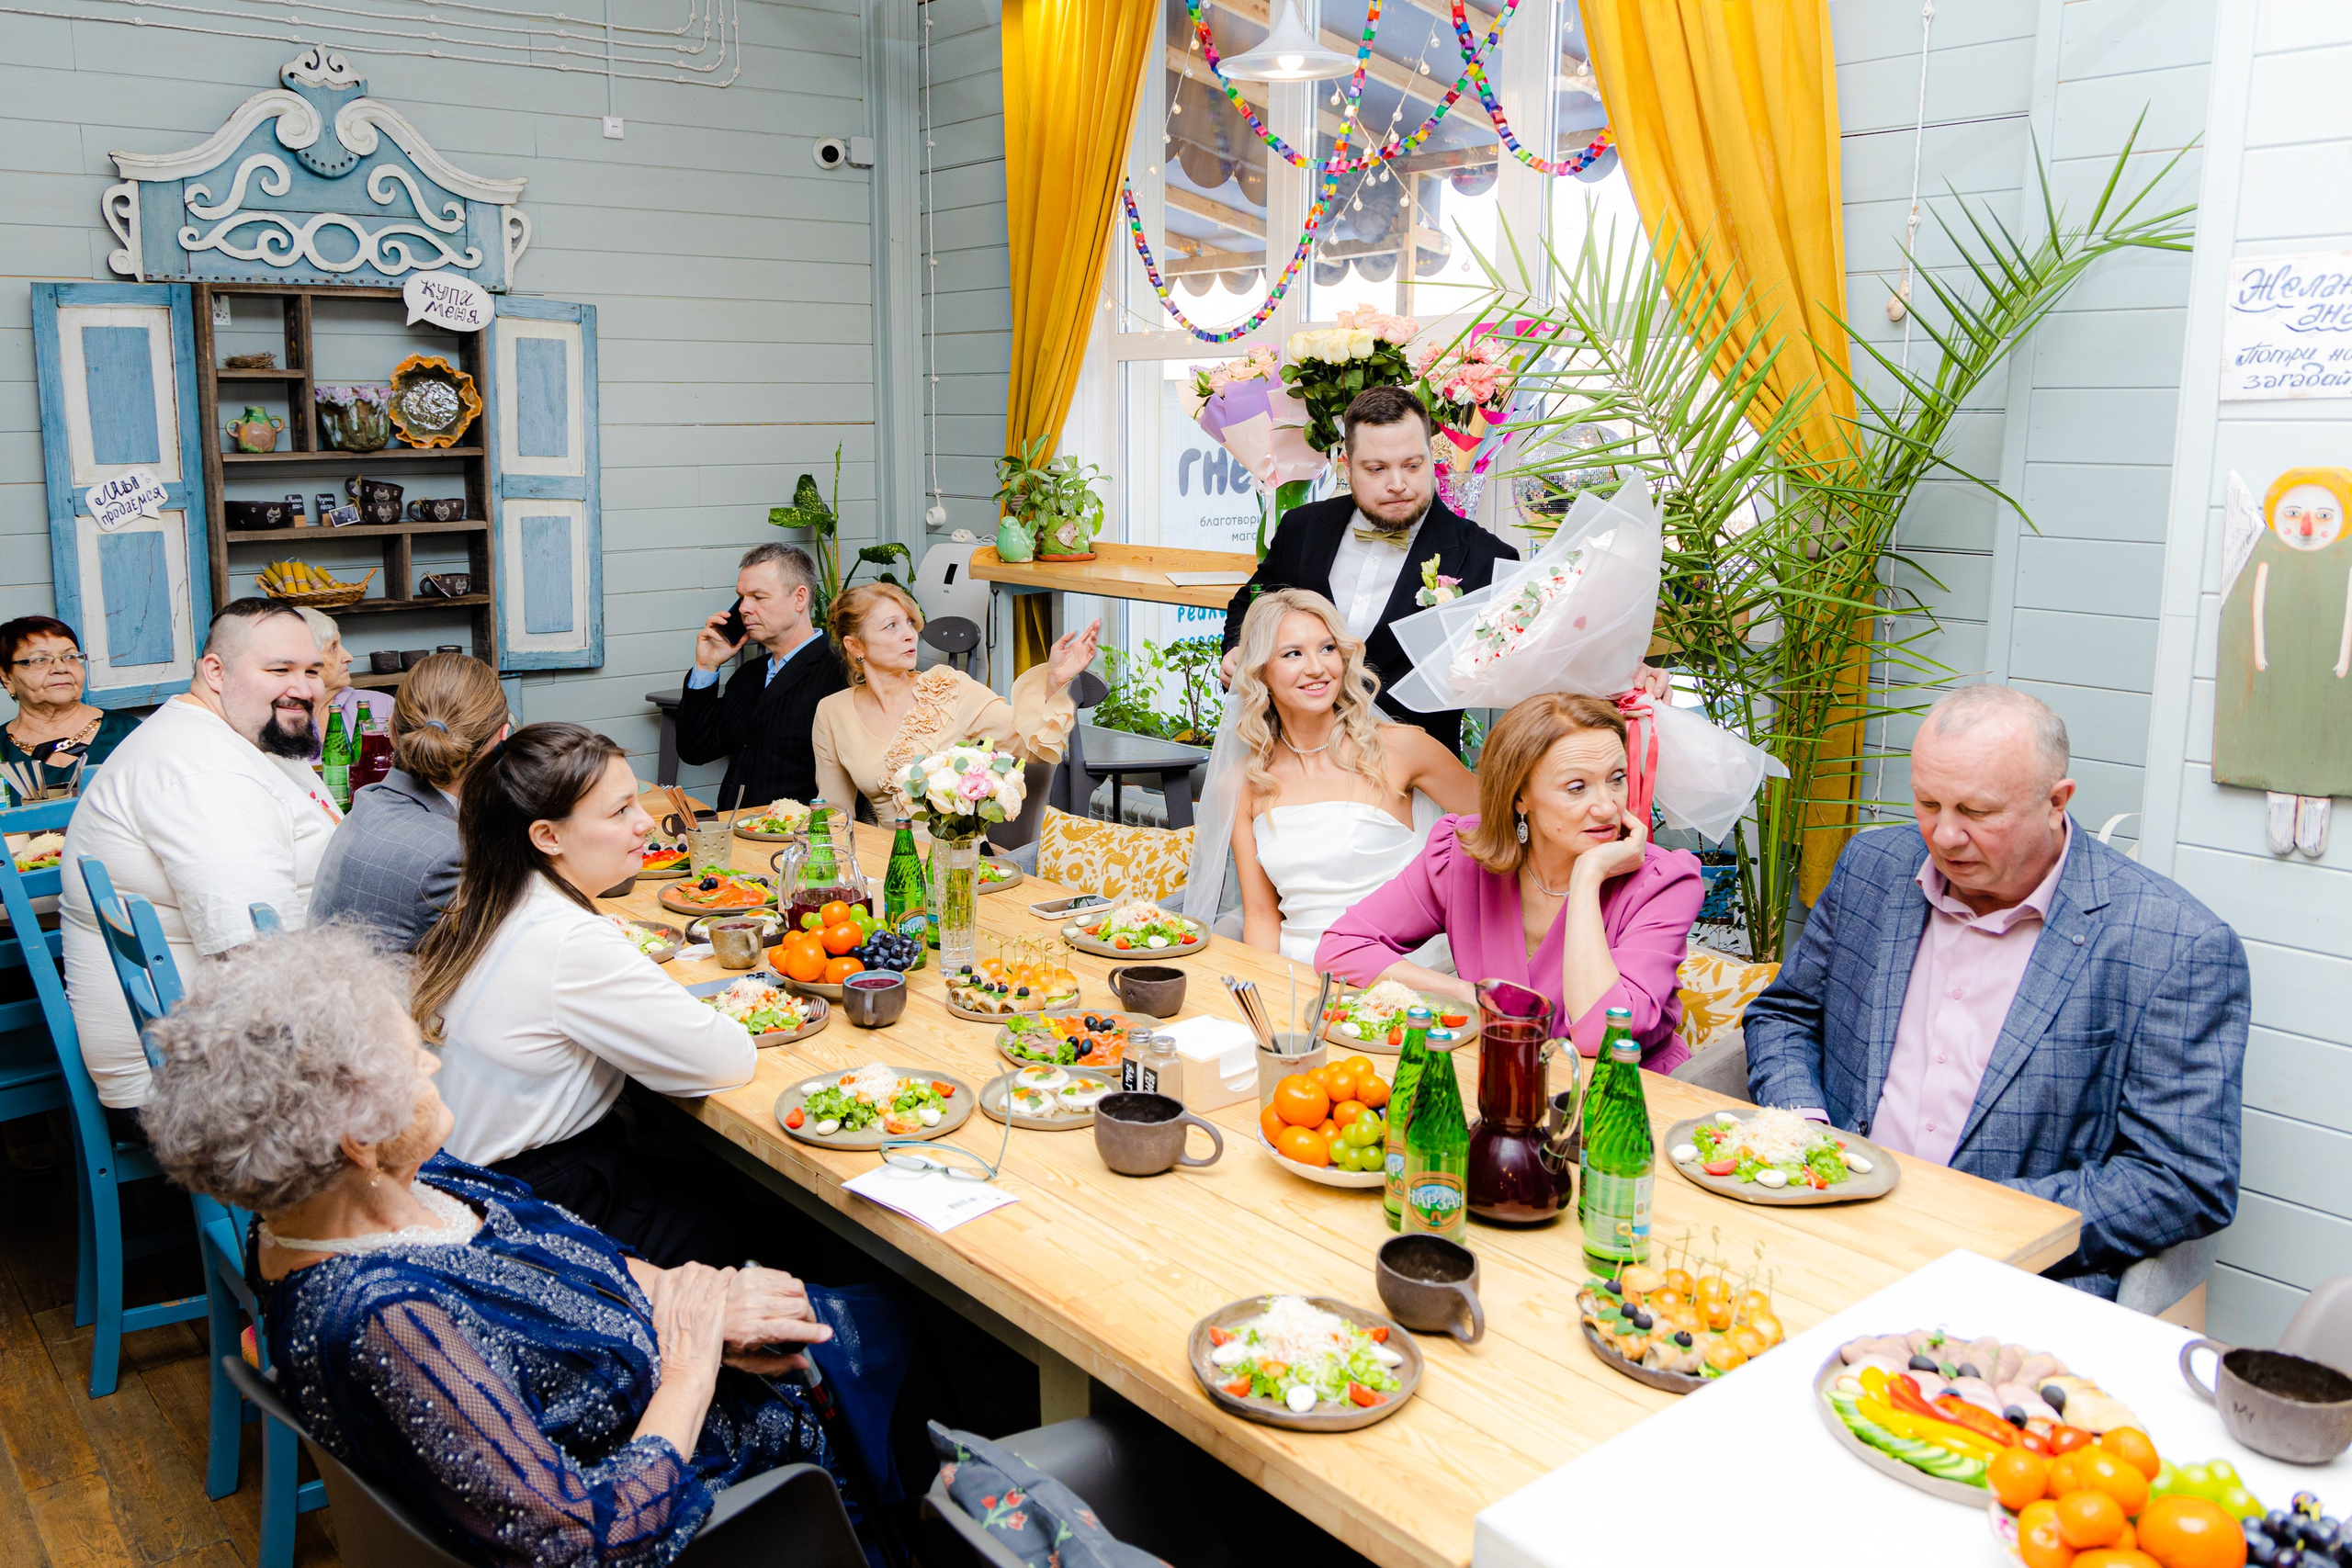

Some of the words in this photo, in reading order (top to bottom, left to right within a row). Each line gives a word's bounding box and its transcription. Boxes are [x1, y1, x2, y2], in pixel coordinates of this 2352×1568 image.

[1125, 1063, 1135, 1091] SALT
[1144, 1071, 1156, 1093] PEPP
[1407, 1188, 1464, 1211] НАРЗАН
